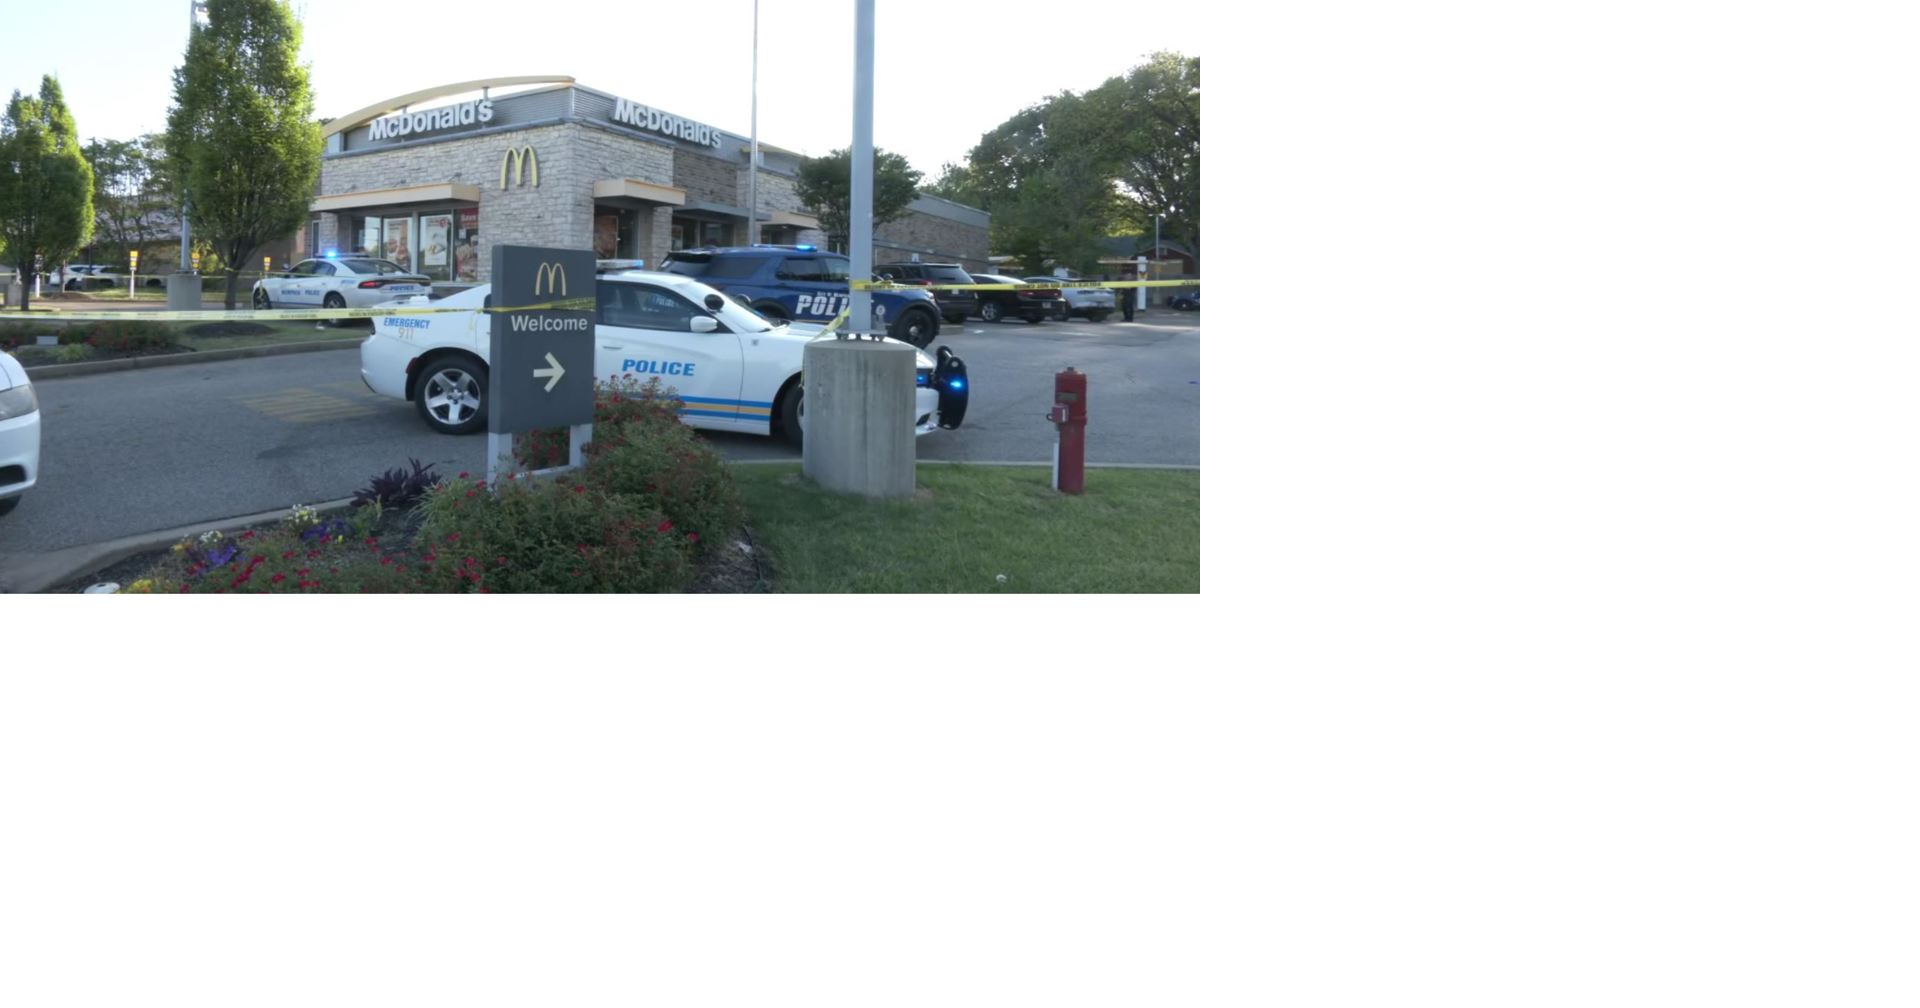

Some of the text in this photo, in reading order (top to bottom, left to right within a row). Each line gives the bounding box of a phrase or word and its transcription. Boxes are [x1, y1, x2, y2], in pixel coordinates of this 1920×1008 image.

[368, 99, 493, 141] McDonald's
[383, 317, 431, 329] EMERGENCY
[511, 315, 588, 332] Welcome
[398, 327, 414, 340] 911
[622, 359, 696, 376] POLICE
